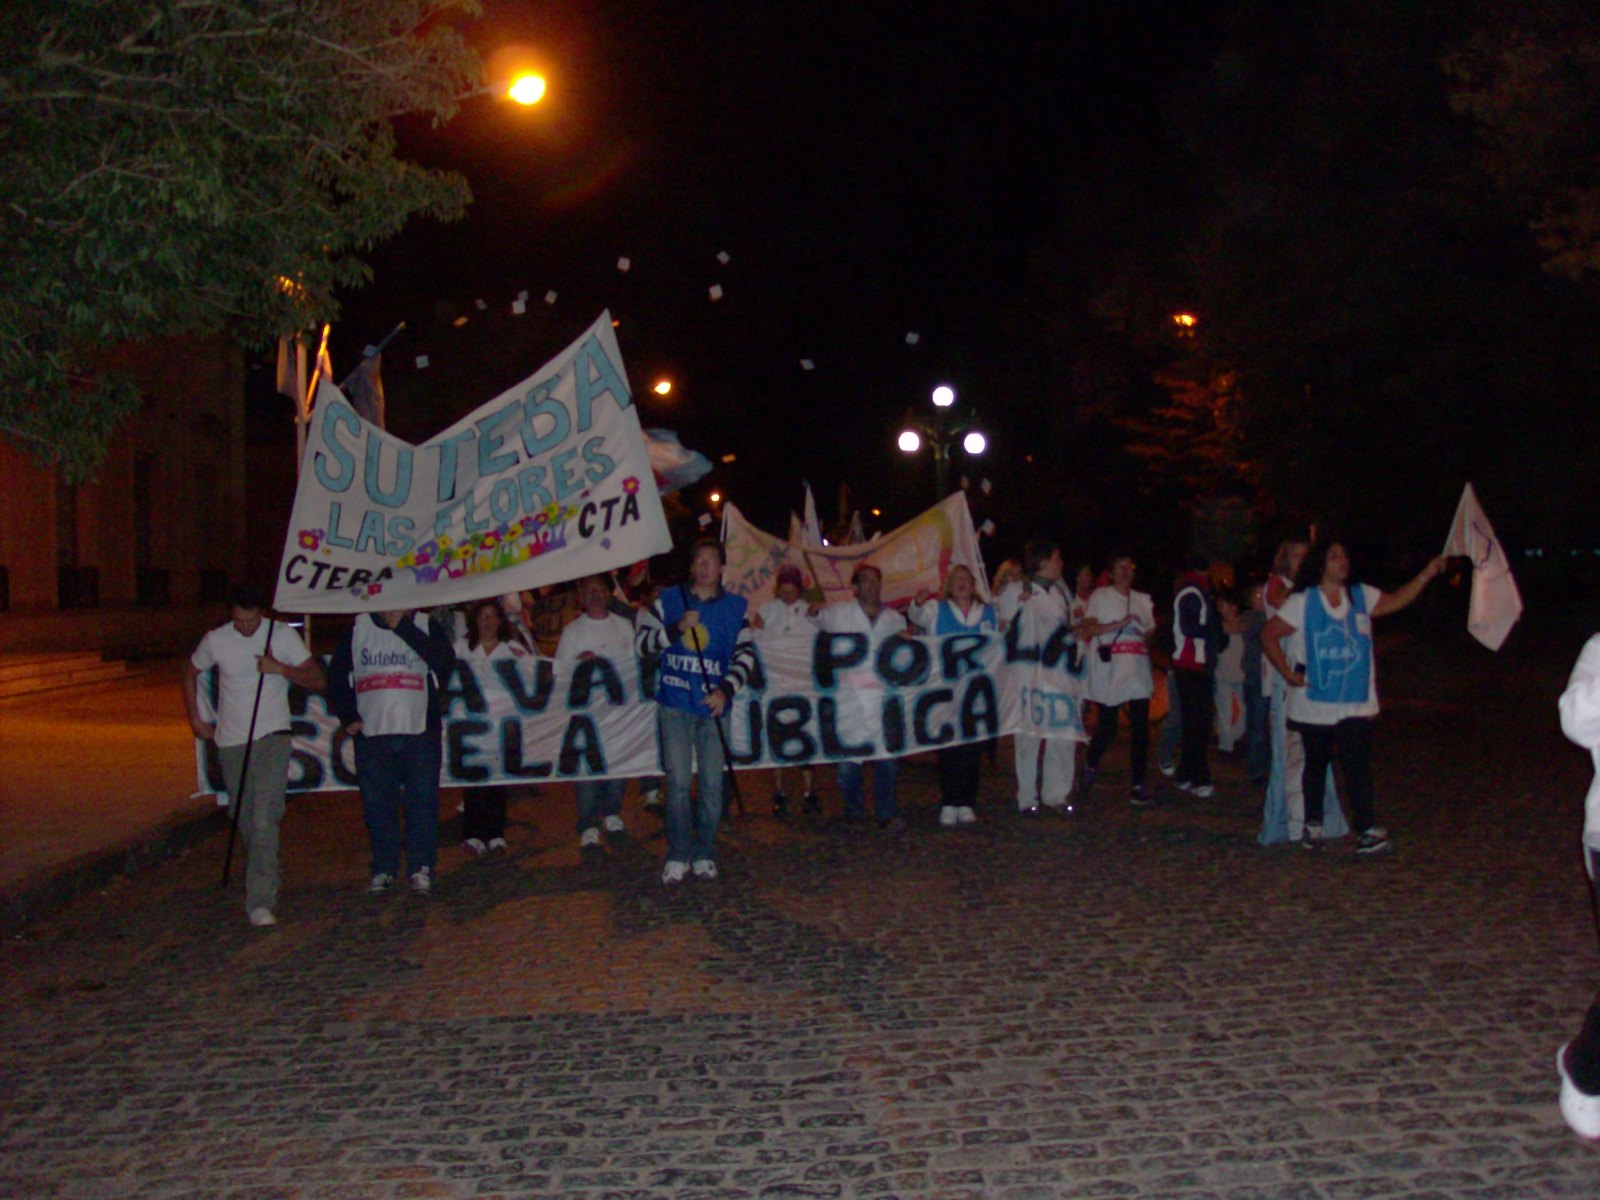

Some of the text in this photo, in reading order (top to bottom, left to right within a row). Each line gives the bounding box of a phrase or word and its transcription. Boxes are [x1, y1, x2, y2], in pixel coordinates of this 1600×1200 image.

[314, 334, 634, 508] SUTEBA
[327, 436, 615, 557] LAS FLORES
[579, 492, 641, 539] CTA
[362, 648, 407, 666] Suteba
[814, 631, 988, 688] POR
[1004, 611, 1085, 675] LA
